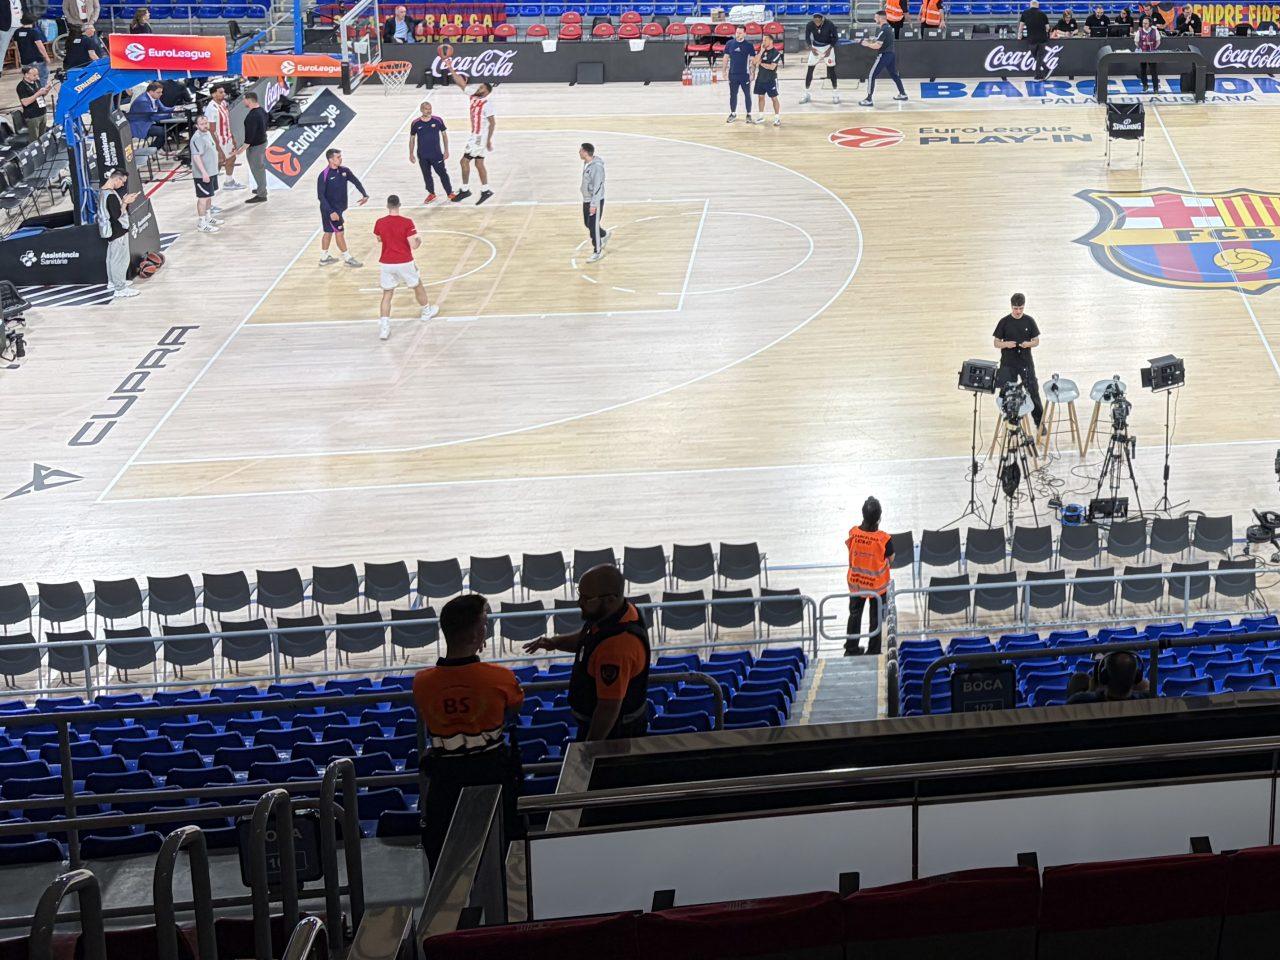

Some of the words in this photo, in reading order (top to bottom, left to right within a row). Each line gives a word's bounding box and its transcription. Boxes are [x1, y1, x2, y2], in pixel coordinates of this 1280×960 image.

[149, 48, 211, 60] EuroLeague
[985, 45, 1063, 74] Coca-Cla
[297, 64, 342, 73] EuroLeagu
[919, 126, 1072, 135] EuroLeague
[920, 134, 1093, 145] PLAY-IN
[1174, 228, 1275, 241] FCB
[67, 325, 200, 447] CUPRA
[963, 679, 1003, 692] BOCA
